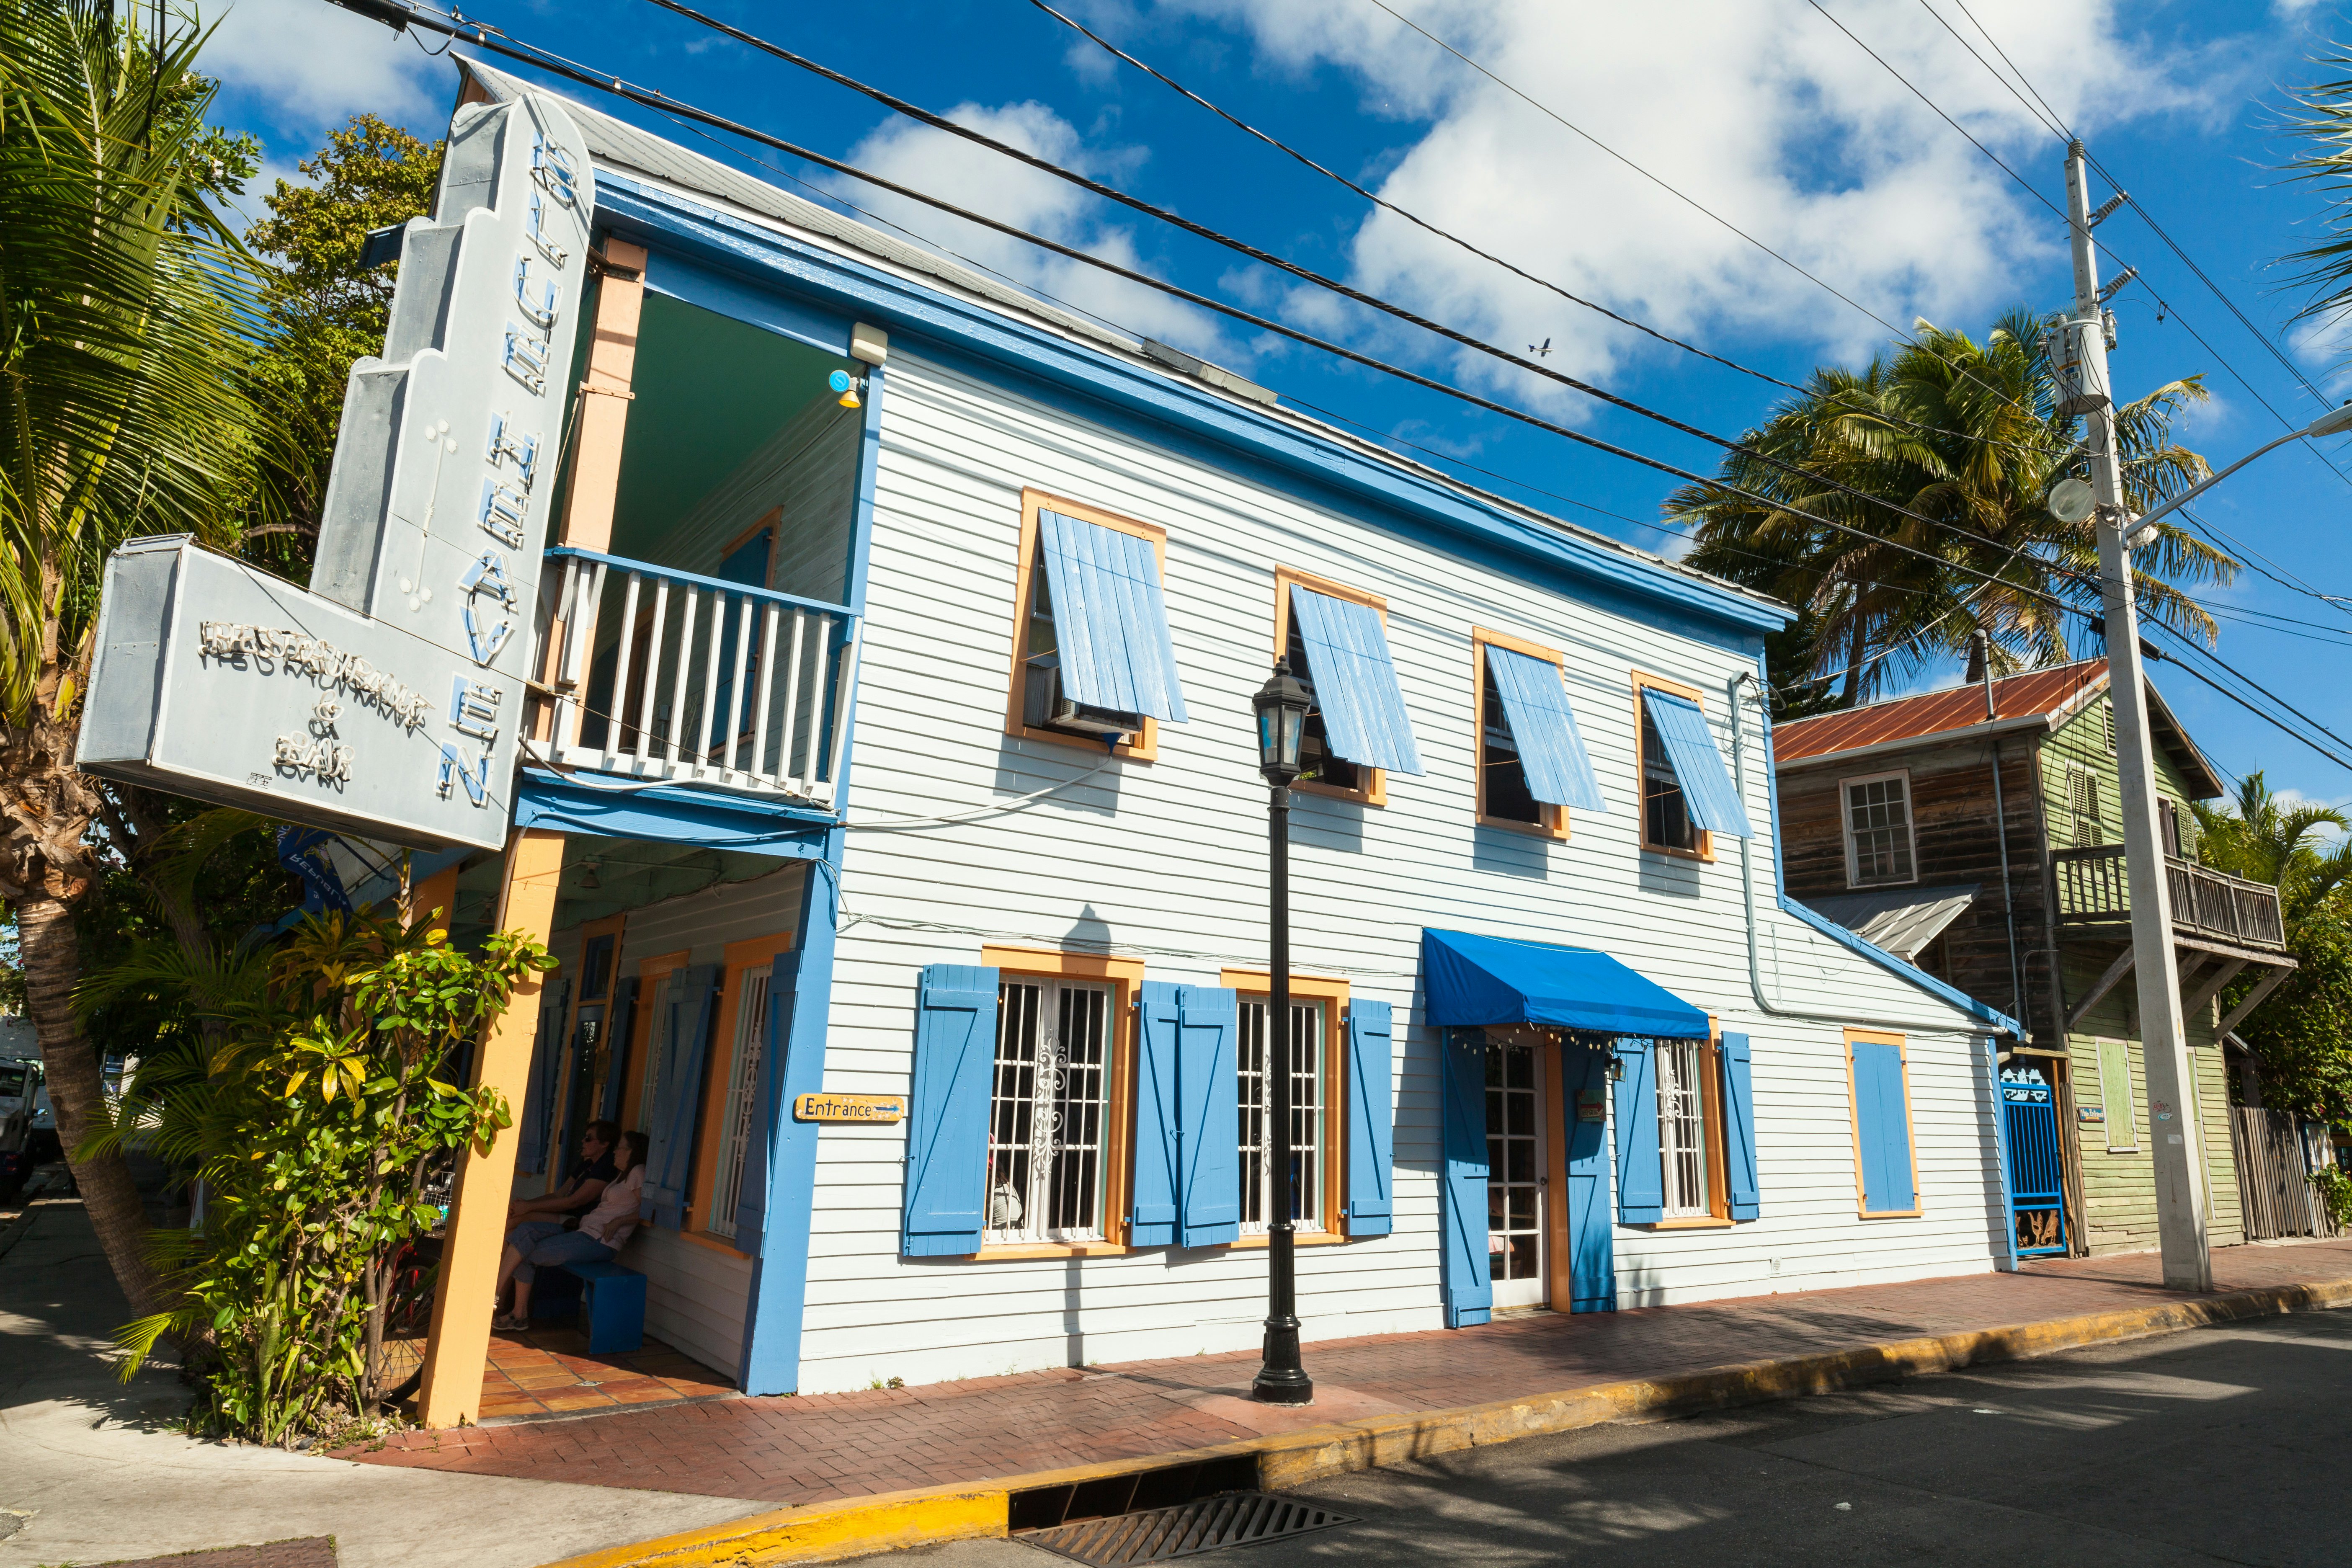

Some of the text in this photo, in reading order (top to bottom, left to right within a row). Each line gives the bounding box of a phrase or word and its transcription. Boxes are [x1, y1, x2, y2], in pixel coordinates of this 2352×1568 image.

[433, 129, 580, 809] BLUE HEAVEN
[199, 622, 436, 726] RESTAURANT
[316, 689, 344, 721] &
[271, 730, 355, 781] BAR
[805, 1097, 871, 1116] Entrance
